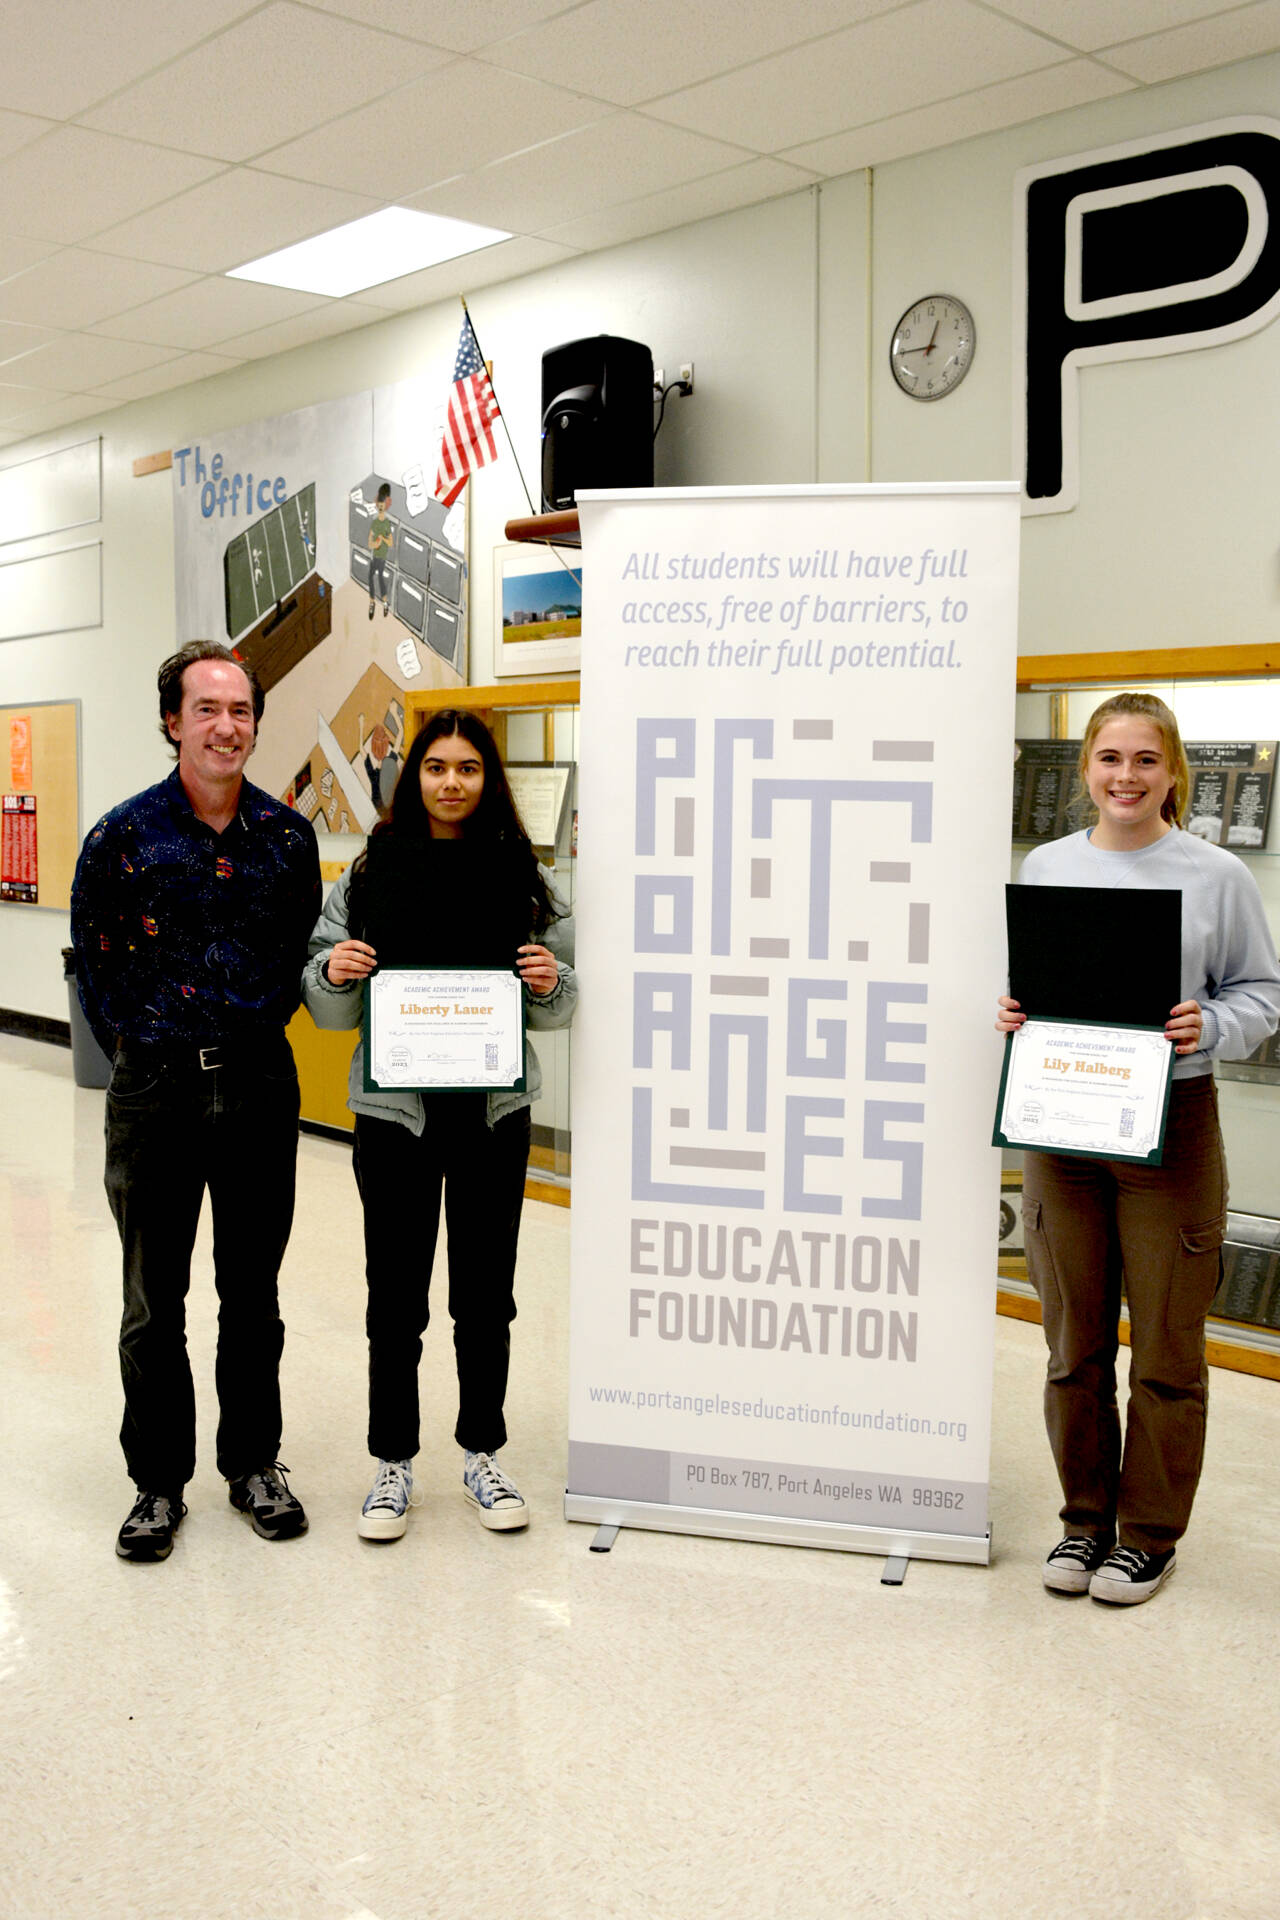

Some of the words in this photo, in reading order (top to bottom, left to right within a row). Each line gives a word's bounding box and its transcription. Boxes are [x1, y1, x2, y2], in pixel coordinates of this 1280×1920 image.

[927, 305, 936, 317] 12
[953, 319, 960, 330] 2
[1016, 116, 1280, 514] P
[927, 379, 934, 390] 6
[941, 370, 948, 382] 5
[174, 446, 223, 487] The
[201, 473, 287, 518] Office
[622, 552, 660, 580] All
[666, 551, 781, 580] students
[788, 550, 839, 579] will
[846, 549, 913, 579] have
[914, 549, 969, 586] full
[621, 598, 713, 629] access,
[716, 595, 773, 631] free
[779, 594, 811, 631] of
[812, 594, 932, 629] barriers,
[940, 596, 969, 624] to
[624, 639, 700, 668] reach
[706, 639, 770, 668] their
[771, 639, 824, 676] full
[829, 638, 963, 676] potential.
[399, 1003, 450, 1018] Liberty
[453, 1003, 494, 1015] Lauer
[1042, 1057, 1071, 1074] Lily
[1074, 1060, 1132, 1080] Halberg
[629, 1218, 921, 1297] EDUCATION
[628, 1287, 919, 1363] FOUNDATION
[588, 1384, 968, 1442] www.portangeleseducationfoundation.org
[686, 1464, 706, 1484] PO
[711, 1467, 738, 1488] Box
[742, 1470, 773, 1492] 787,
[778, 1474, 809, 1495] Port
[813, 1478, 873, 1503] Angeles
[877, 1485, 903, 1504] WA
[912, 1489, 965, 1511] 98362
